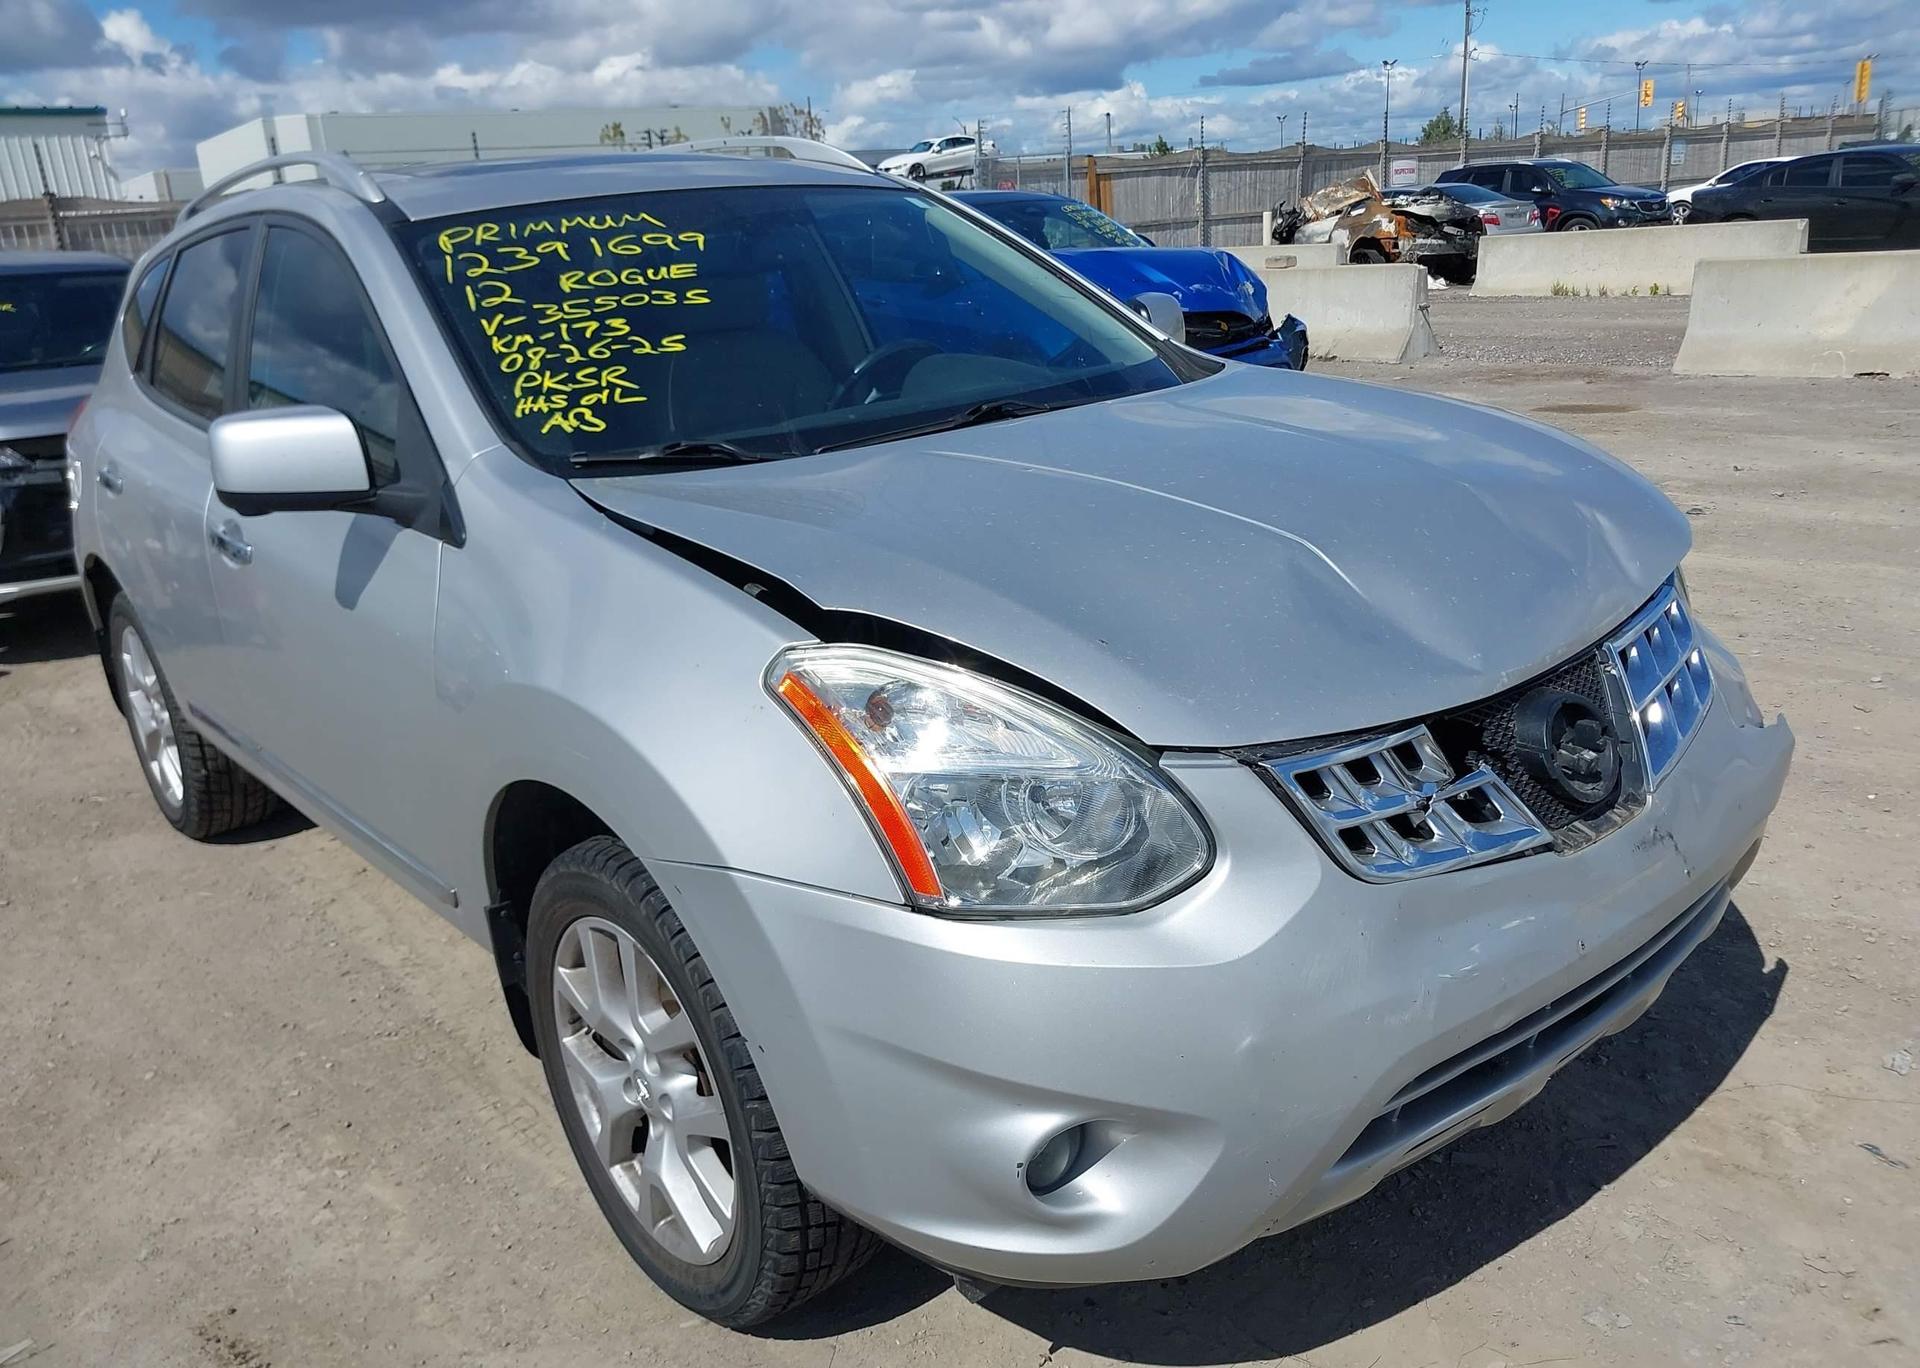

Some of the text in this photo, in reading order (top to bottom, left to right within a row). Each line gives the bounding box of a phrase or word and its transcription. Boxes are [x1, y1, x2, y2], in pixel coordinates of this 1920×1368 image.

[438, 213, 666, 253] PRIMMUM
[466, 264, 697, 311] 12 ROGUE
[501, 335, 686, 372] 08-26-25
